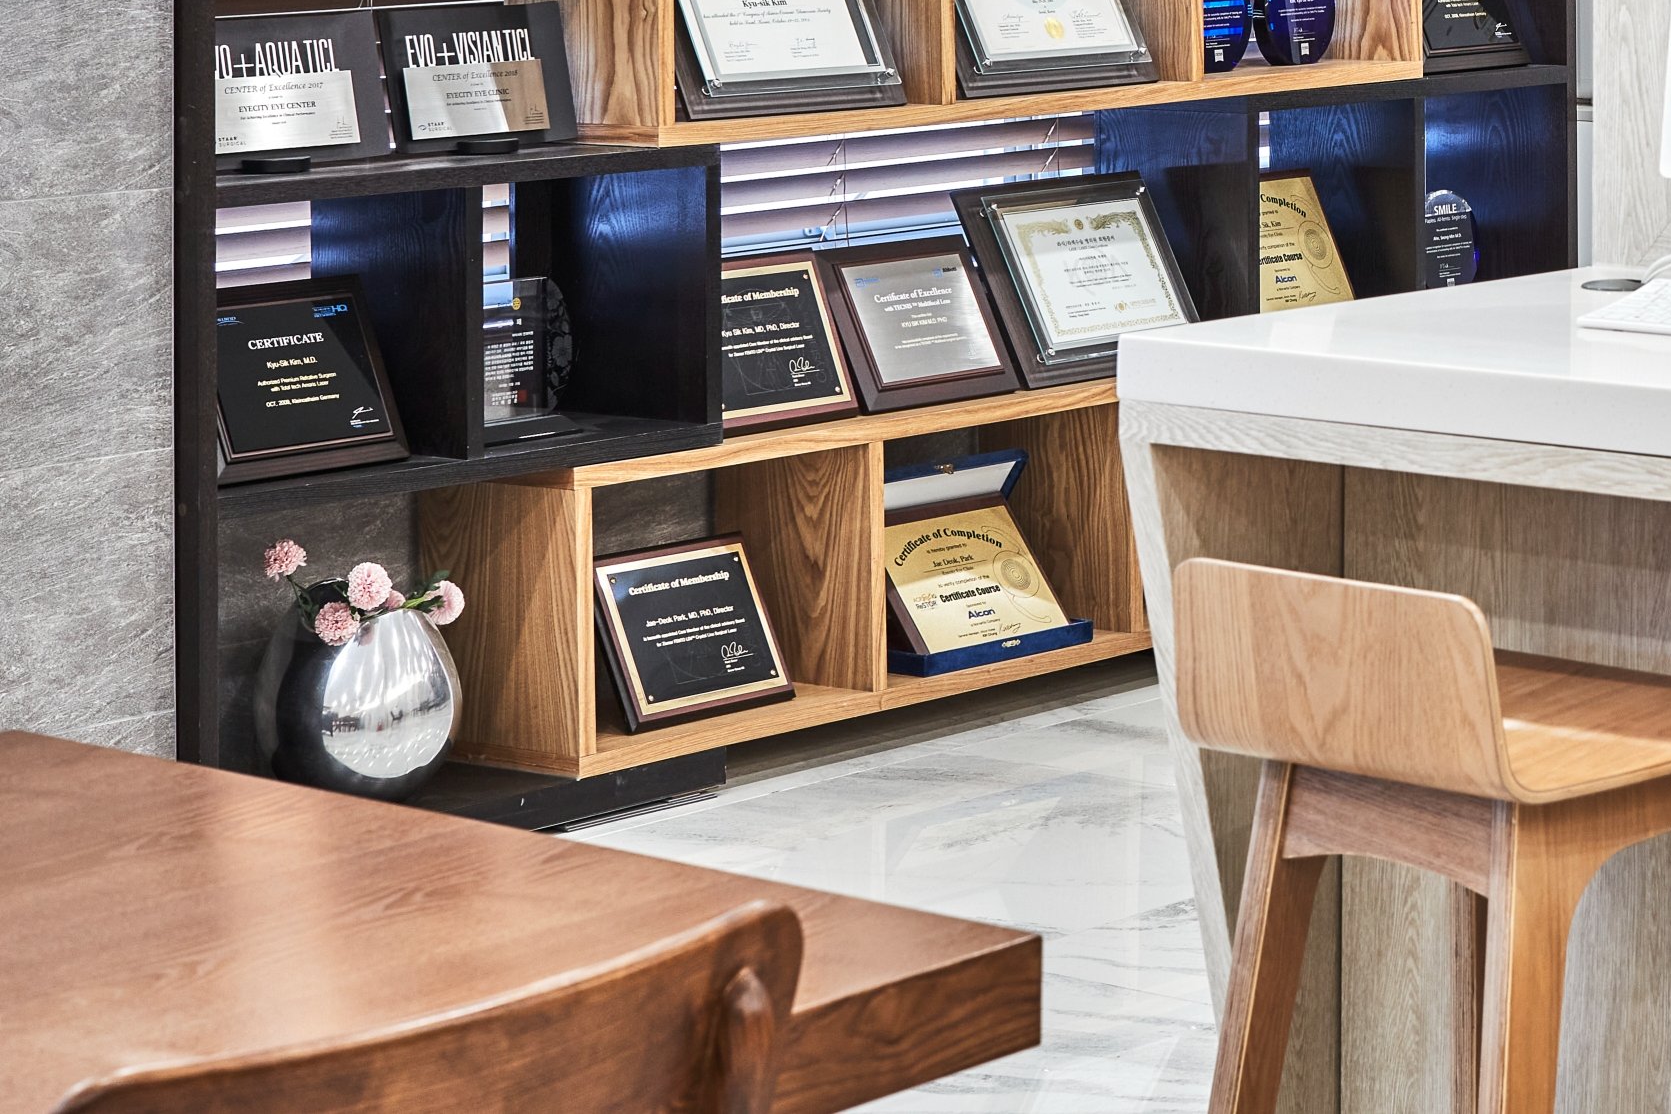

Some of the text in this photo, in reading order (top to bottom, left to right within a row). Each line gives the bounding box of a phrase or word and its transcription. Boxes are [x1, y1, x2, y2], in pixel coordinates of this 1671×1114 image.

[742, 0, 770, 8] Kyu-sik
[502, 28, 535, 61] TICL
[433, 73, 461, 81] CENTER
[463, 72, 469, 82] of
[471, 70, 504, 79] Excellence
[225, 85, 258, 94] CENTER
[260, 85, 266, 93] of
[269, 82, 306, 91] Excellence
[239, 105, 269, 113] EYECITY
[286, 101, 316, 109] CENTER
[1260, 193, 1306, 218] Completion
[1434, 204, 1457, 215] SMILE
[1284, 252, 1303, 261] Course
[1275, 275, 1297, 284] Alcon
[743, 292, 751, 301] of
[752, 287, 799, 300] Membership
[874, 292, 910, 303] Certificate
[918, 287, 952, 298] Excellence
[332, 304, 348, 313] HQ
[722, 328, 732, 338] Kyu
[743, 327, 754, 335] Kim,
[766, 324, 779, 332] PhD,
[780, 322, 800, 331] Director
[248, 332, 324, 350] CERTIFICATE
[267, 356, 318, 370] Kyu-Sik Kim, M.D.
[894, 527, 1002, 567] Certificate of Completion
[933, 560, 943, 568] Jae
[629, 570, 730, 596] Certificate of Membership
[940, 585, 1000, 603] Certificate Course
[646, 605, 734, 628] Jae-Deok Park, MD, PhD, Director
[968, 608, 995, 620] Alcon
